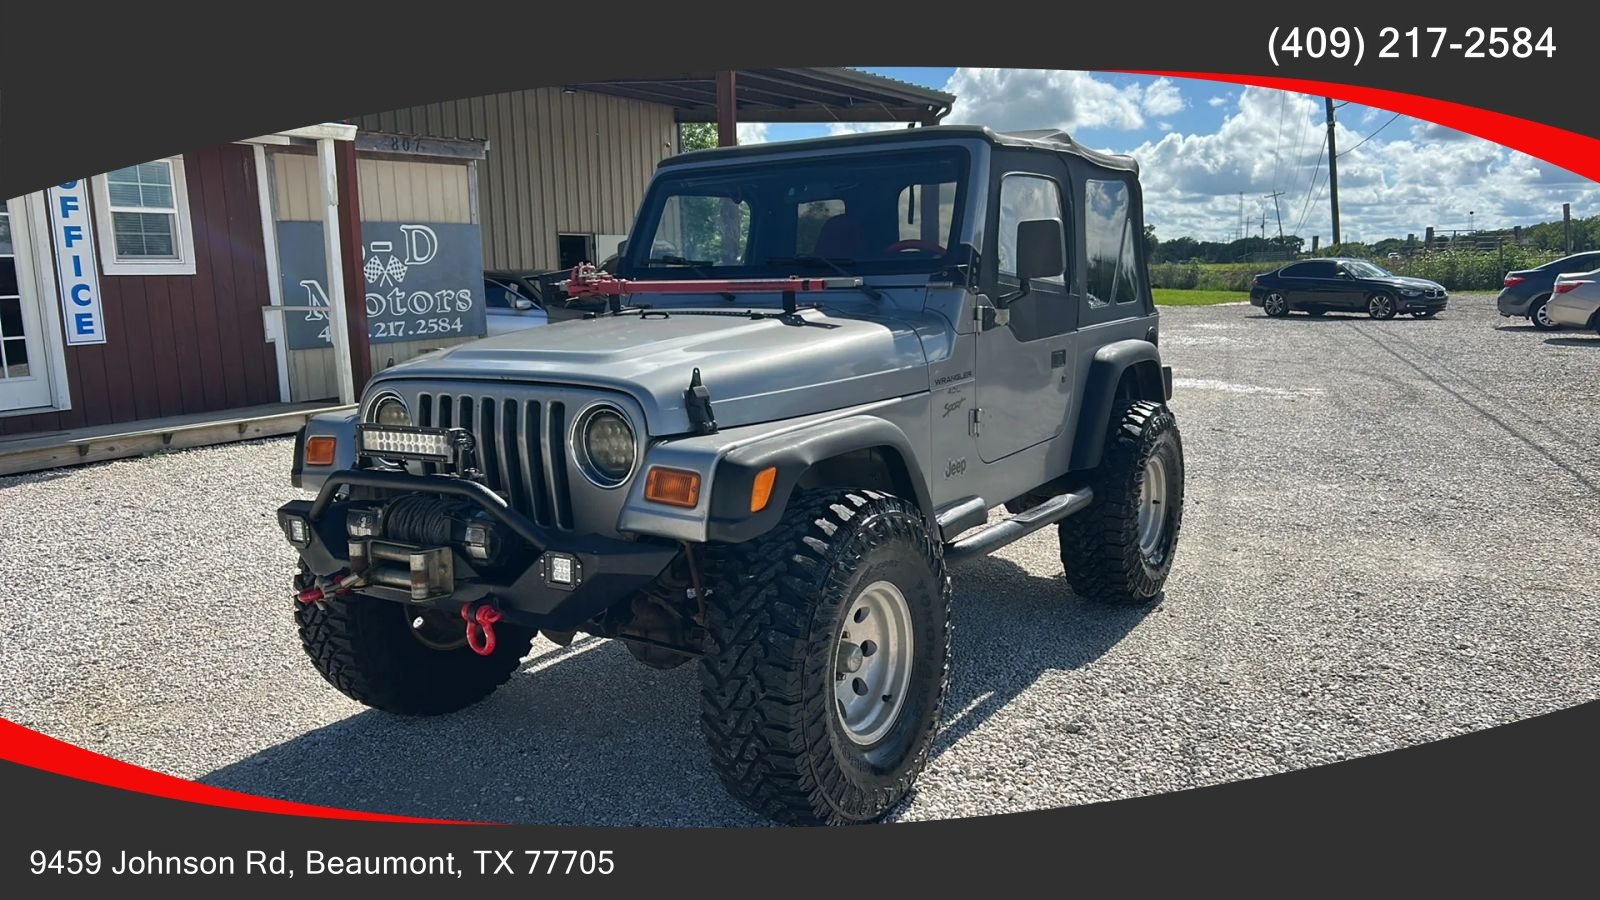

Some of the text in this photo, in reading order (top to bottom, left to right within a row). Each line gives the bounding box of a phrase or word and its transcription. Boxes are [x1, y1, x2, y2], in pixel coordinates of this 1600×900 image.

[391, 135, 422, 152] 807
[317, 317, 464, 342] 4.217.2584
[934, 370, 972, 385] WRANGLER
[945, 458, 967, 478] Jeep
